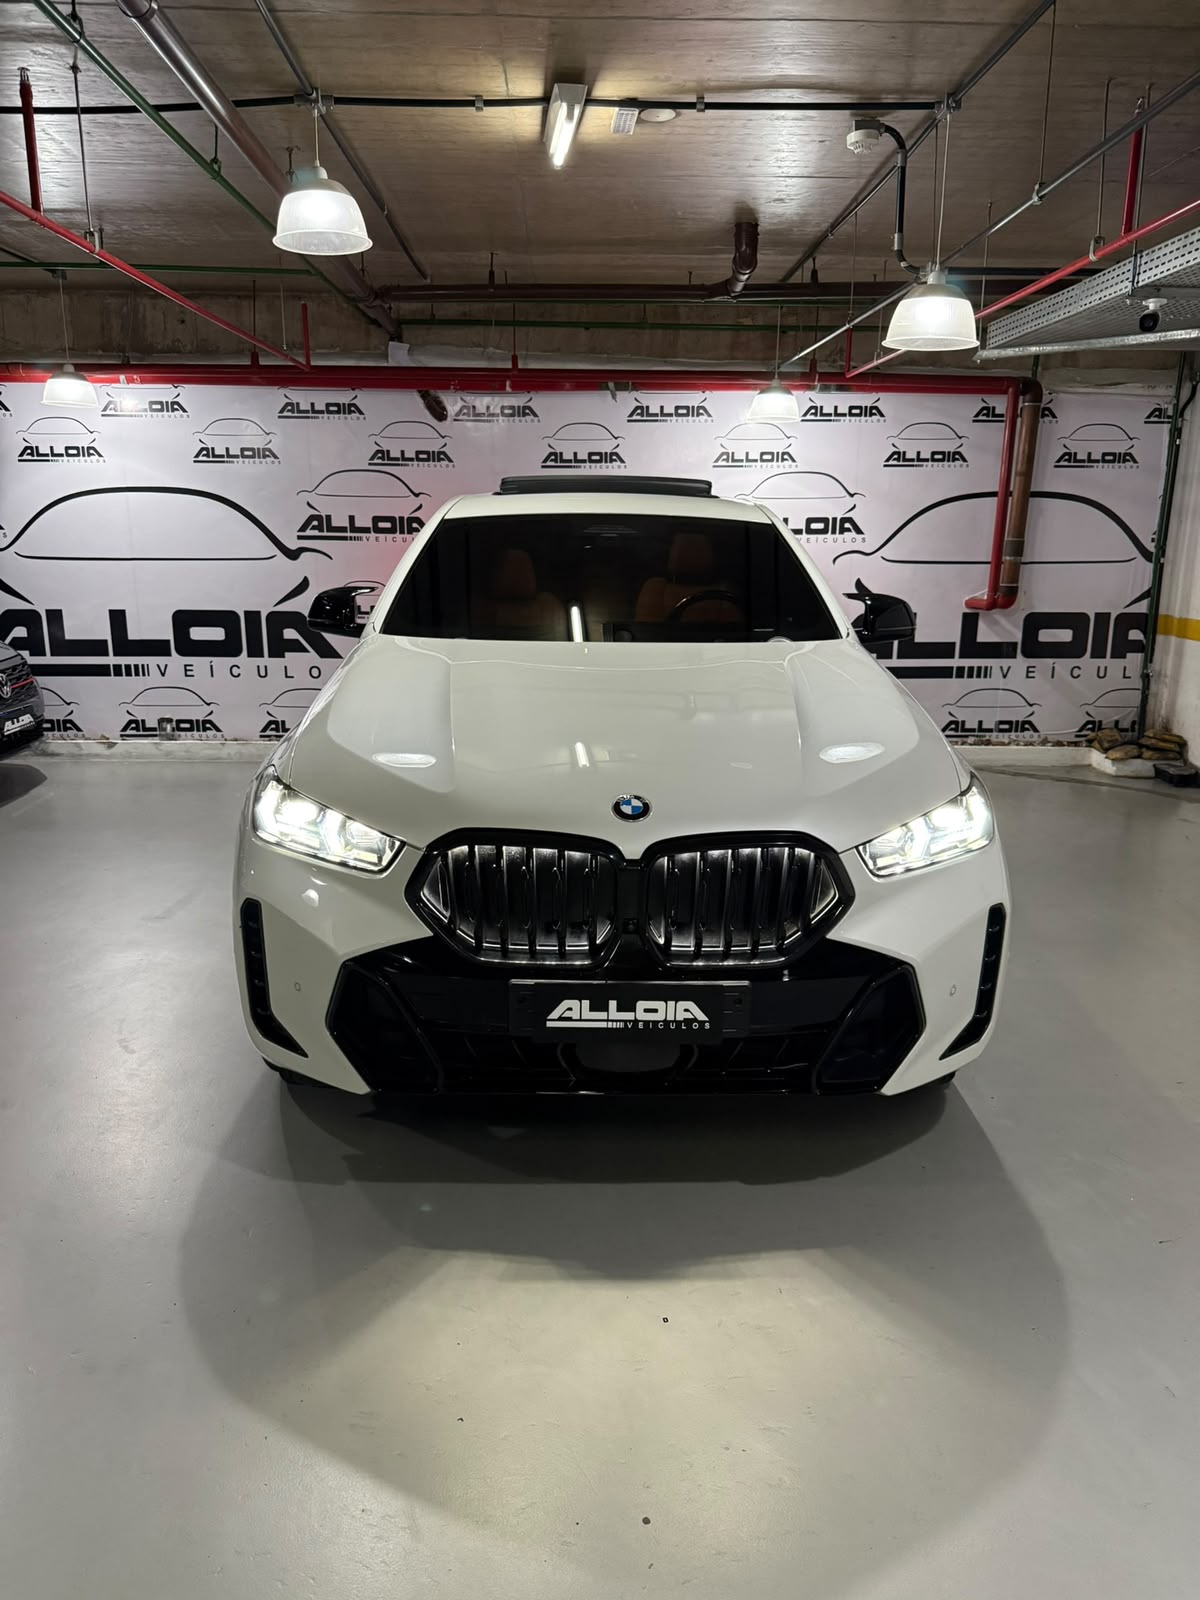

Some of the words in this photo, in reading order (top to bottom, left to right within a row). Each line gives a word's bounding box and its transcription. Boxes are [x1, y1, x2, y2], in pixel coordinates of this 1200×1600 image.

[101, 400, 189, 414] AOIA
[278, 401, 365, 416] ALLOIA
[454, 404, 539, 418] ALLOIA
[627, 405, 713, 418] ALLOIA
[800, 405, 886, 418] ALLOIA
[973, 405, 1058, 419] ALA
[18, 445, 105, 458] ALLOIA
[193, 446, 280, 460] ALLOIA
[368, 449, 454, 463] ALLOIA
[541, 451, 626, 464] ALLOIA
[712, 451, 797, 463] ALLOIA
[884, 450, 969, 463] ALLOIA
[1055, 452, 1139, 464] ALLOIA
[297, 513, 426, 535] ALLOIA
[782, 516, 865, 535] LOIA
[0, 608, 344, 659] ALLOIA
[156, 660, 322, 679] VEÍCULO
[1000, 662, 1132, 679] VEÍCUL
[42, 718, 84, 733] OIA
[941, 719, 1041, 733] ALLOIA
[546, 999, 710, 1021] ALLOIA
